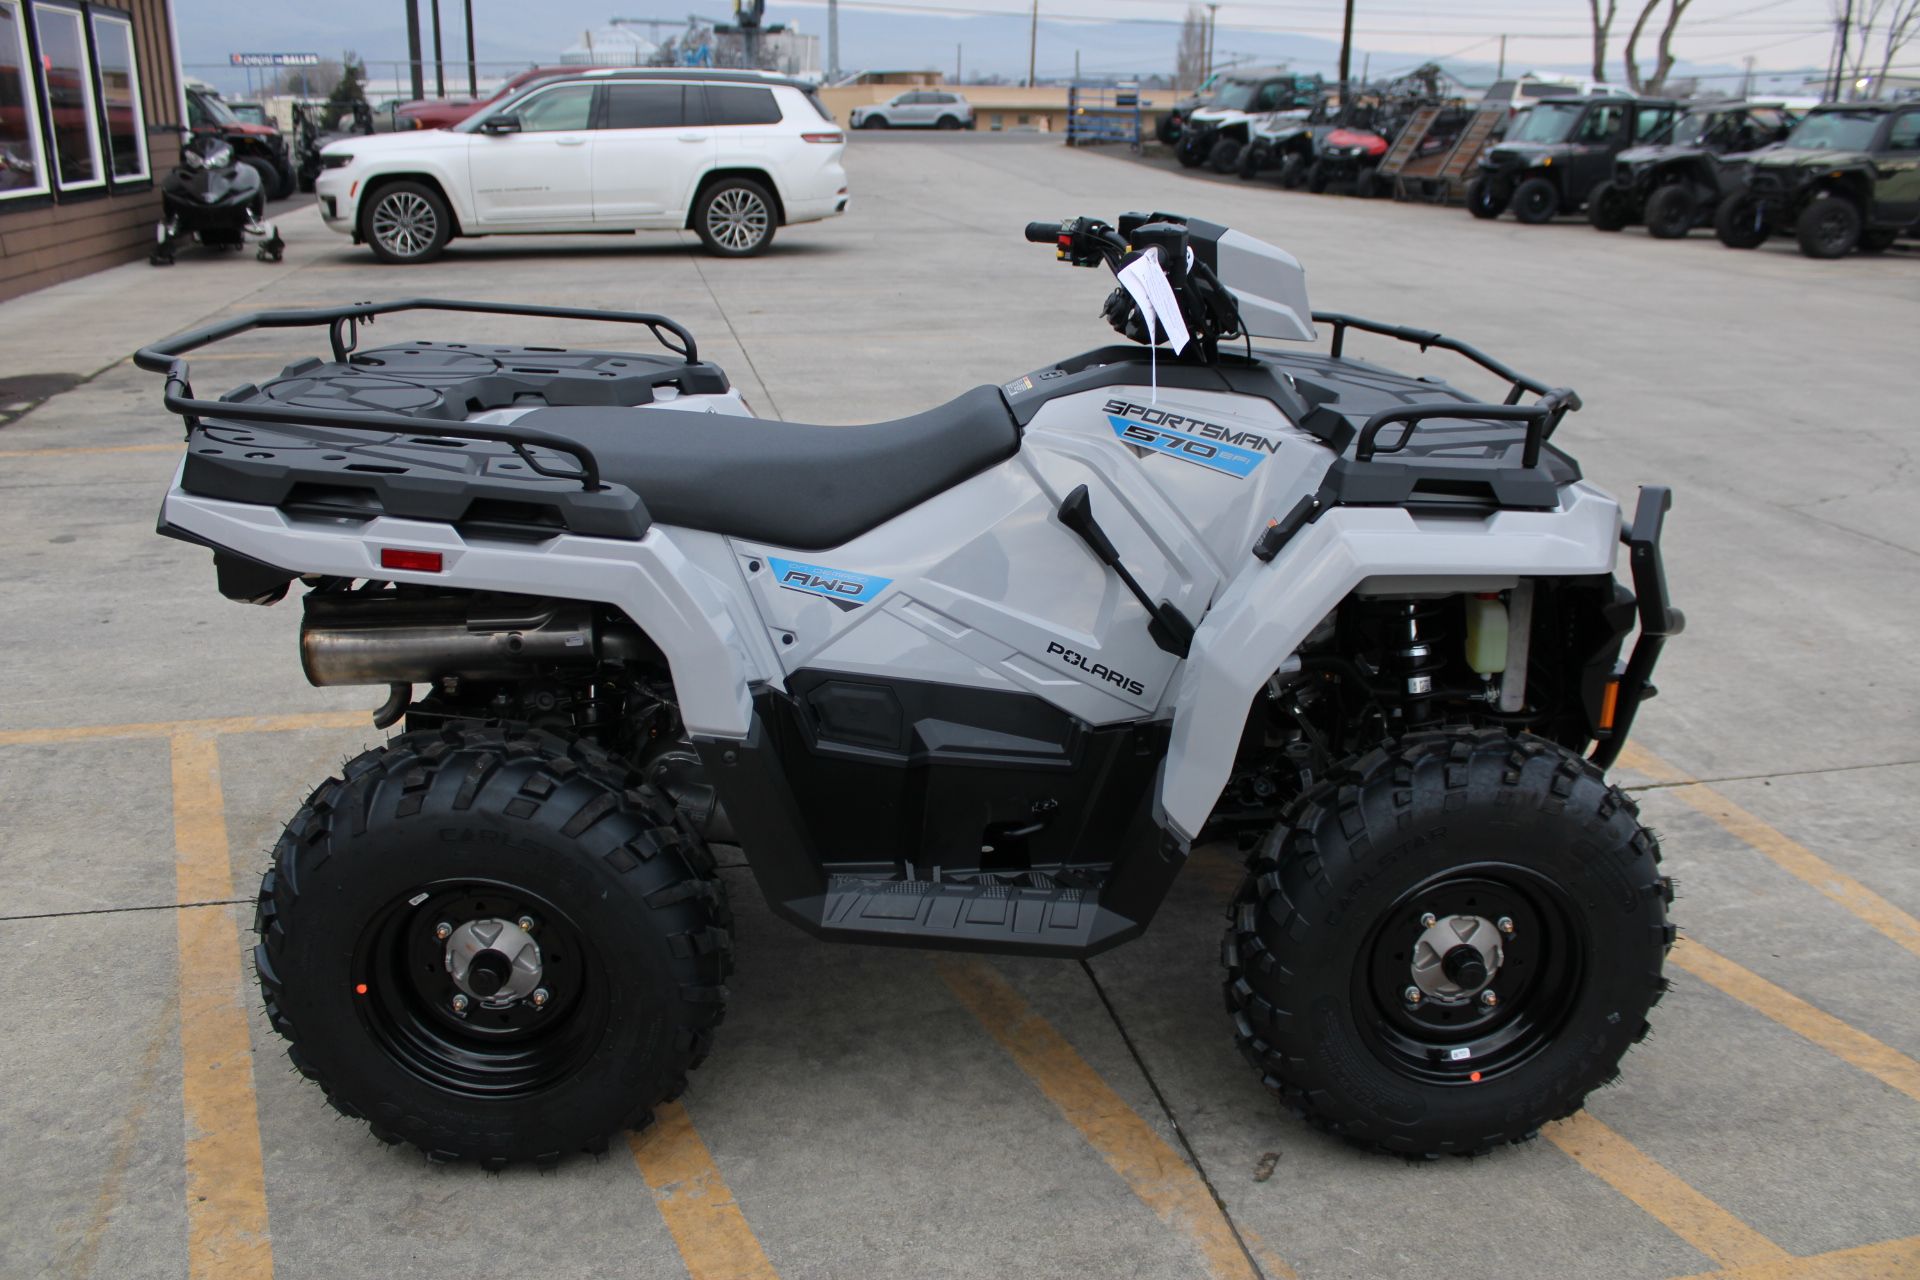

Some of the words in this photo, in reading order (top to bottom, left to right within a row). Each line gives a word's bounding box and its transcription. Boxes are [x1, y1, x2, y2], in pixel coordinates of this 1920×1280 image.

[1102, 399, 1282, 454] SPORTSMAN
[1121, 424, 1218, 459] 570
[783, 570, 864, 595] AWD
[1046, 641, 1145, 696] POLARIS
